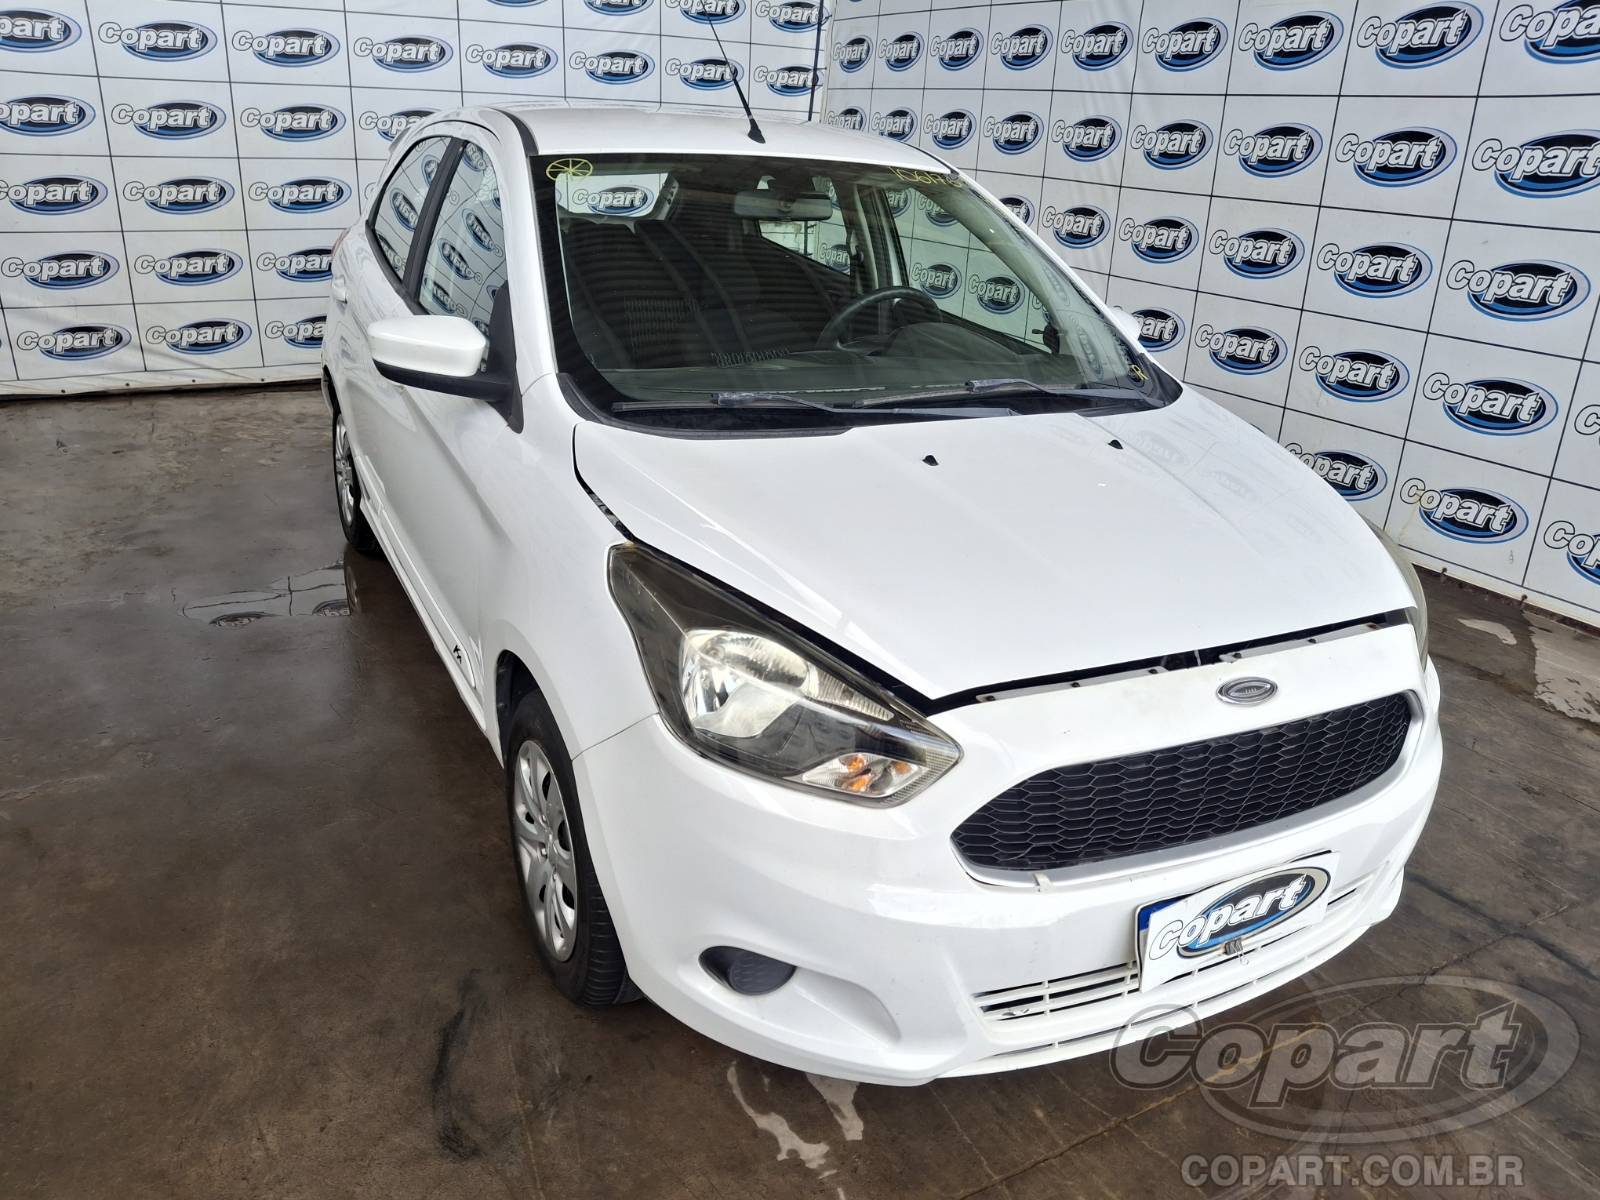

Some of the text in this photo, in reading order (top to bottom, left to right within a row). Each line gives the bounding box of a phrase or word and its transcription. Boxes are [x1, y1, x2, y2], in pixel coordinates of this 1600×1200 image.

[754, 1, 821, 24] Copart
[0, 16, 65, 42] part
[99, 21, 203, 52] Copart
[1239, 20, 1331, 59] Copart
[1356, 9, 1468, 56] Copart
[1499, 4, 1600, 50] Copa
[231, 29, 326, 58] Copart
[353, 36, 443, 62] Copart
[834, 41, 869, 64] Copart
[878, 40, 919, 64] Copart
[931, 34, 977, 62] Copart
[992, 29, 1046, 61] Copart
[1062, 27, 1124, 60] Copart
[1143, 25, 1219, 60] Copart
[466, 45, 546, 69] Copart
[568, 51, 645, 75] Copart
[665, 59, 732, 81] Copart
[0, 101, 78, 126] opart
[111, 103, 210, 132] Copart
[240, 107, 332, 132] Copart
[872, 113, 913, 136] Copart
[923, 112, 973, 139] Copart
[984, 116, 1038, 145] Copart
[1051, 119, 1114, 149] Copart
[1131, 125, 1206, 158] Copart
[1224, 128, 1315, 164] Copart
[1335, 133, 1443, 173] Copart
[122, 180, 222, 204] Copart
[248, 181, 341, 204] Copart
[572, 190, 650, 208] Copart
[1042, 206, 1102, 239] Copart
[1119, 217, 1189, 249] Copart
[819, 243, 850, 264] Copar
[1209, 229, 1294, 265] Copart
[1, 256, 105, 283] Copart
[133, 253, 230, 276] Copart
[256, 252, 333, 275] Copar
[911, 263, 955, 288] Copart
[1316, 243, 1419, 283] Copart
[969, 275, 1017, 303] Copart
[1446, 260, 1575, 305] Copart
[16, 328, 119, 352] Copart
[145, 323, 240, 347] Copart
[264, 320, 325, 341] Copa
[1133, 315, 1175, 342] art
[1195, 324, 1276, 363] Copart
[1298, 346, 1400, 391] Copart
[1423, 372, 1547, 424] Copart
[1400, 477, 1513, 534] Copart
[1149, 875, 1307, 961] Copart
